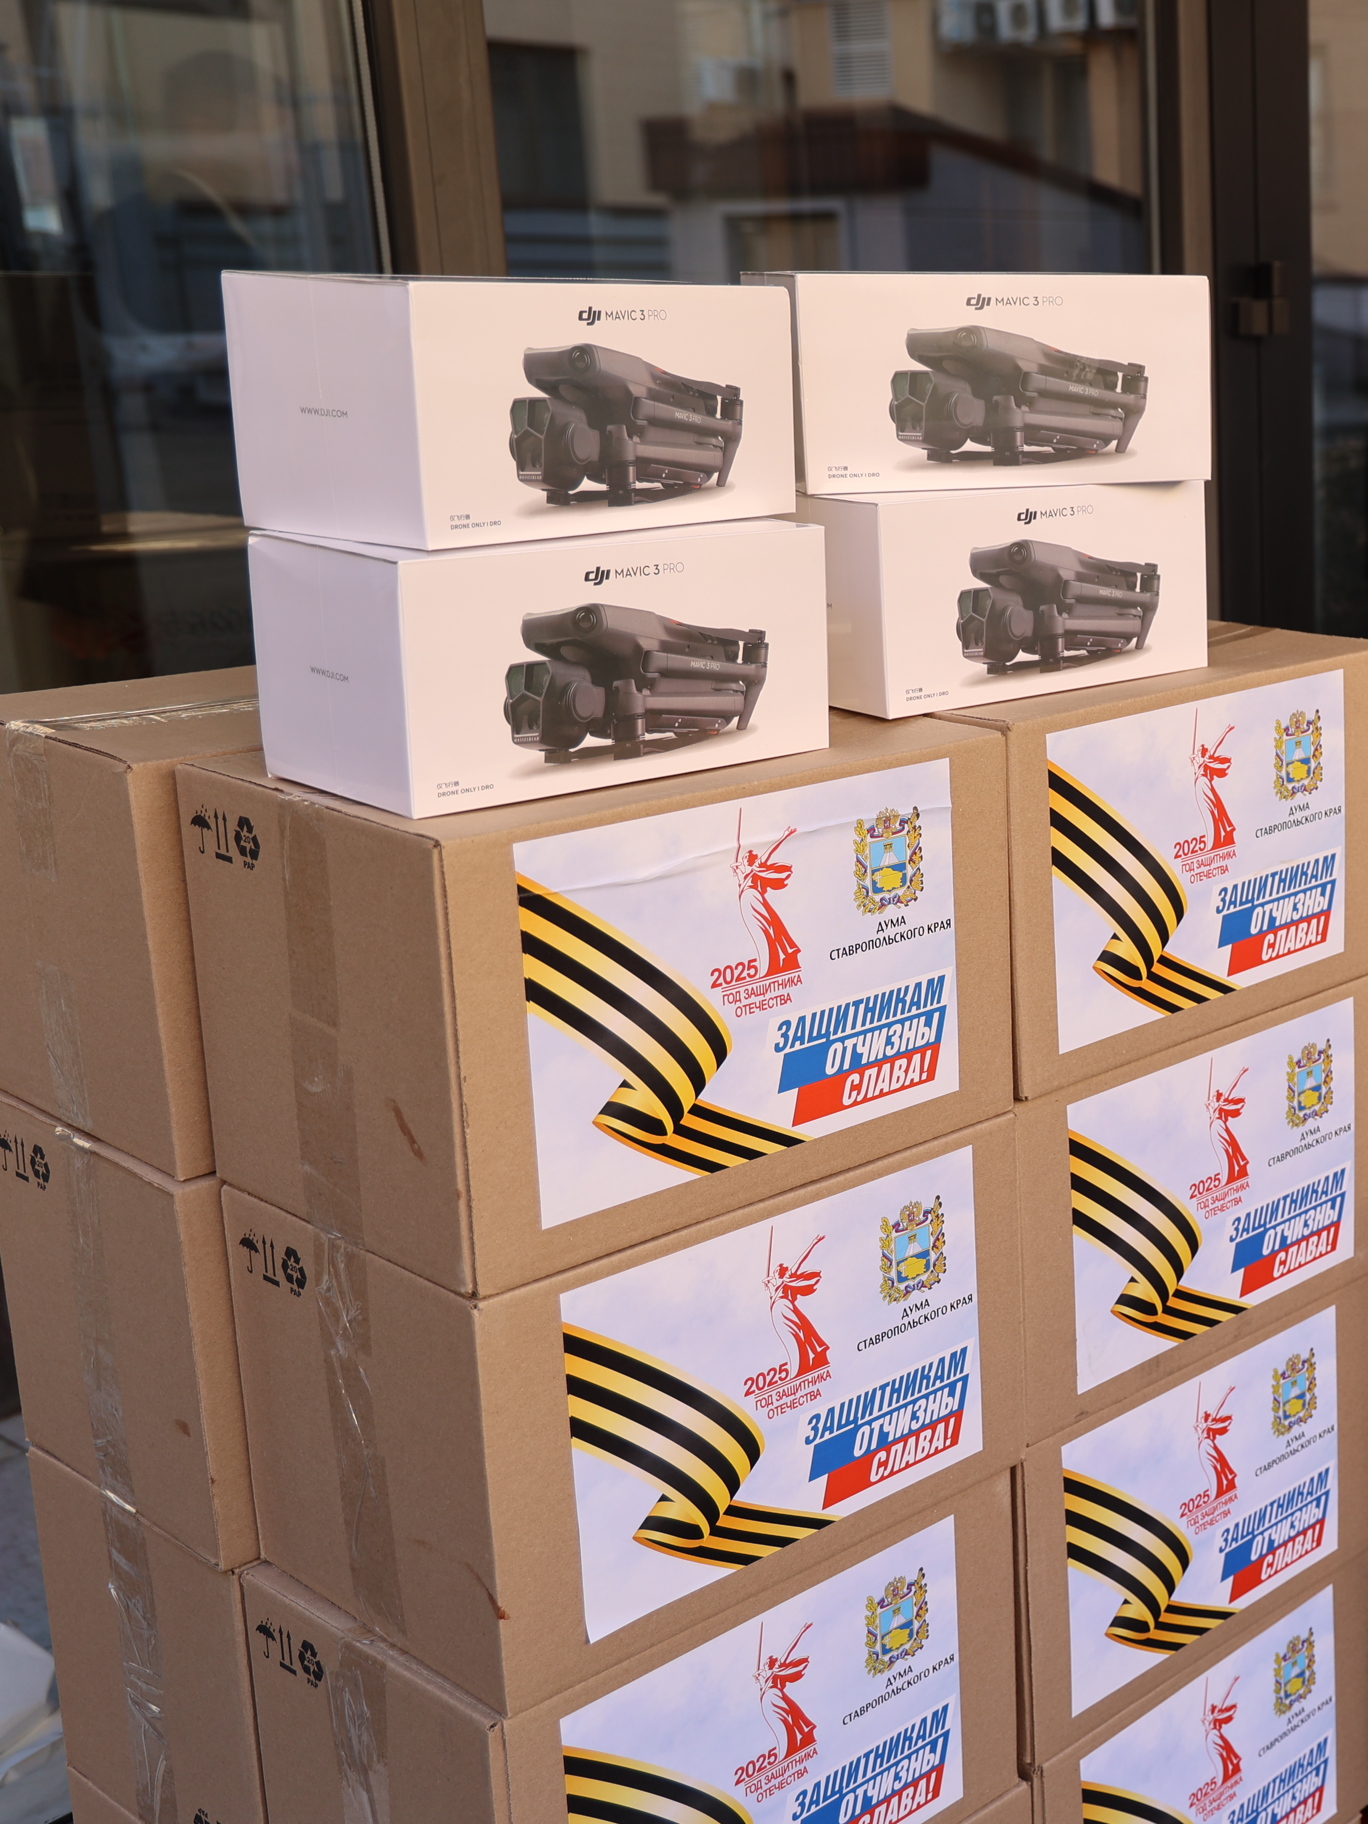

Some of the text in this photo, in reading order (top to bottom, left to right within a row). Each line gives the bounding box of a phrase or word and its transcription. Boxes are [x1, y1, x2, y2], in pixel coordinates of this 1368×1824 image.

[605, 310, 637, 321] MAVIC
[640, 310, 646, 321] 3
[648, 309, 667, 321] PRO
[995, 296, 1030, 306] MAVIC
[1032, 296, 1039, 306] 3
[1041, 296, 1063, 306] PRO
[300, 406, 348, 418] WWW.DJI.COM
[450, 522, 470, 530] DRONE
[471, 521, 486, 529] ONLY
[1040, 507, 1067, 519] MAVIC
[1070, 506, 1075, 516] 3
[1077, 505, 1094, 515] PRO
[615, 566, 650, 579] MAVIC
[653, 564, 660, 575] 3
[663, 562, 684, 574] PRO
[310, 665, 349, 683] WWW.DJI.COM
[690, 661, 705, 669] MAVIC
[438, 790, 459, 798] DRONE
[1288, 802, 1310, 817] ДУМА
[1255, 805, 1342, 838] СТАВРОПОЛЬСКОГО КРАЯ
[243, 835, 251, 844] 20
[1174, 835, 1207, 860] 2025
[244, 860, 255, 870] PAP
[1181, 849, 1237, 875] ГОД ЗАЩИТНИКА
[1189, 864, 1229, 884] ОТЕЧЕСТВА
[1216, 852, 1336, 915] ЗАЩИТНИКАМ
[876, 916, 906, 934] ДУМА
[1250, 883, 1333, 935] ОТЧИЗНЫ
[829, 919, 952, 961] СТАВРОПОЛЬСКОГО КРАЯ
[1261, 915, 1325, 961] СЛАВА!
[710, 958, 759, 989] 2025
[722, 975, 803, 1006] ГОД ЗАЩИТНИКА
[735, 993, 792, 1018] ОТЕЧЕСТВА
[774, 974, 946, 1053] ЗАЩИТНИКАМ
[825, 1011, 940, 1076] ОТЧИЗНЫ
[842, 1049, 932, 1106] СЛАВА!
[1267, 1123, 1352, 1167] СТАВРОПОЛЬСКОГО КРАЯ
[1300, 1125, 1321, 1142] ДУМА
[1189, 1172, 1222, 1200] 2025
[1196, 1180, 1250, 1212] ГОД ЗАЩИТНИКА
[1204, 1196, 1243, 1220] ОТЕЧЕСТВА
[1229, 1167, 1346, 1243] ЗАЩИТНИКАМ
[1262, 1196, 1342, 1256] ОТЧИЗНЫ
[1273, 1227, 1335, 1278] СЛАВА!
[290, 1287, 301, 1298] PAP
[857, 1293, 973, 1352] СТАВРОПОЛЬСКОГО КРАЯ
[901, 1298, 930, 1320] ДУМА
[743, 1362, 790, 1397] 2025
[755, 1369, 832, 1411] ГОД ЗАЩИТНИКА
[804, 1345, 968, 1445] ЗАЩИТНИКАМ
[767, 1388, 822, 1420] ОТЕЧЕСТВА
[853, 1381, 963, 1458] ОТЧИЗНЫ
[870, 1416, 956, 1483] СЛАВА!
[1255, 1425, 1335, 1477] СТАВРОПОЛЬСКОГО КРАЯ
[1285, 1431, 1306, 1449] ДУМА
[1180, 1489, 1210, 1518] 2025
[1187, 1493, 1238, 1529] ГОД ЗАЩИТНИКА
[1219, 1466, 1330, 1553] ЗАЩИТНИКАМ
[1194, 1507, 1232, 1535] ОТЕЧЕСТВА
[1250, 1494, 1327, 1561] ОТЧИЗНЫ
[1261, 1523, 1320, 1580] СЛАВА!
[842, 1653, 954, 1725] СТАВРОПОЛЬСКОГО КРАЯ
[885, 1665, 913, 1689] ДУМА
[734, 1746, 778, 1786] 2025
[744, 1748, 818, 1797] ГОД ЗАЩИТНИКА
[791, 1702, 949, 1821] ЗАЩИТНИКАМ
[756, 1766, 809, 1803] ОТЕЧЕСТВА
[838, 1735, 945, 1824] ОТЧИЗНЫ
[1189, 1776, 1217, 1809] 2025
